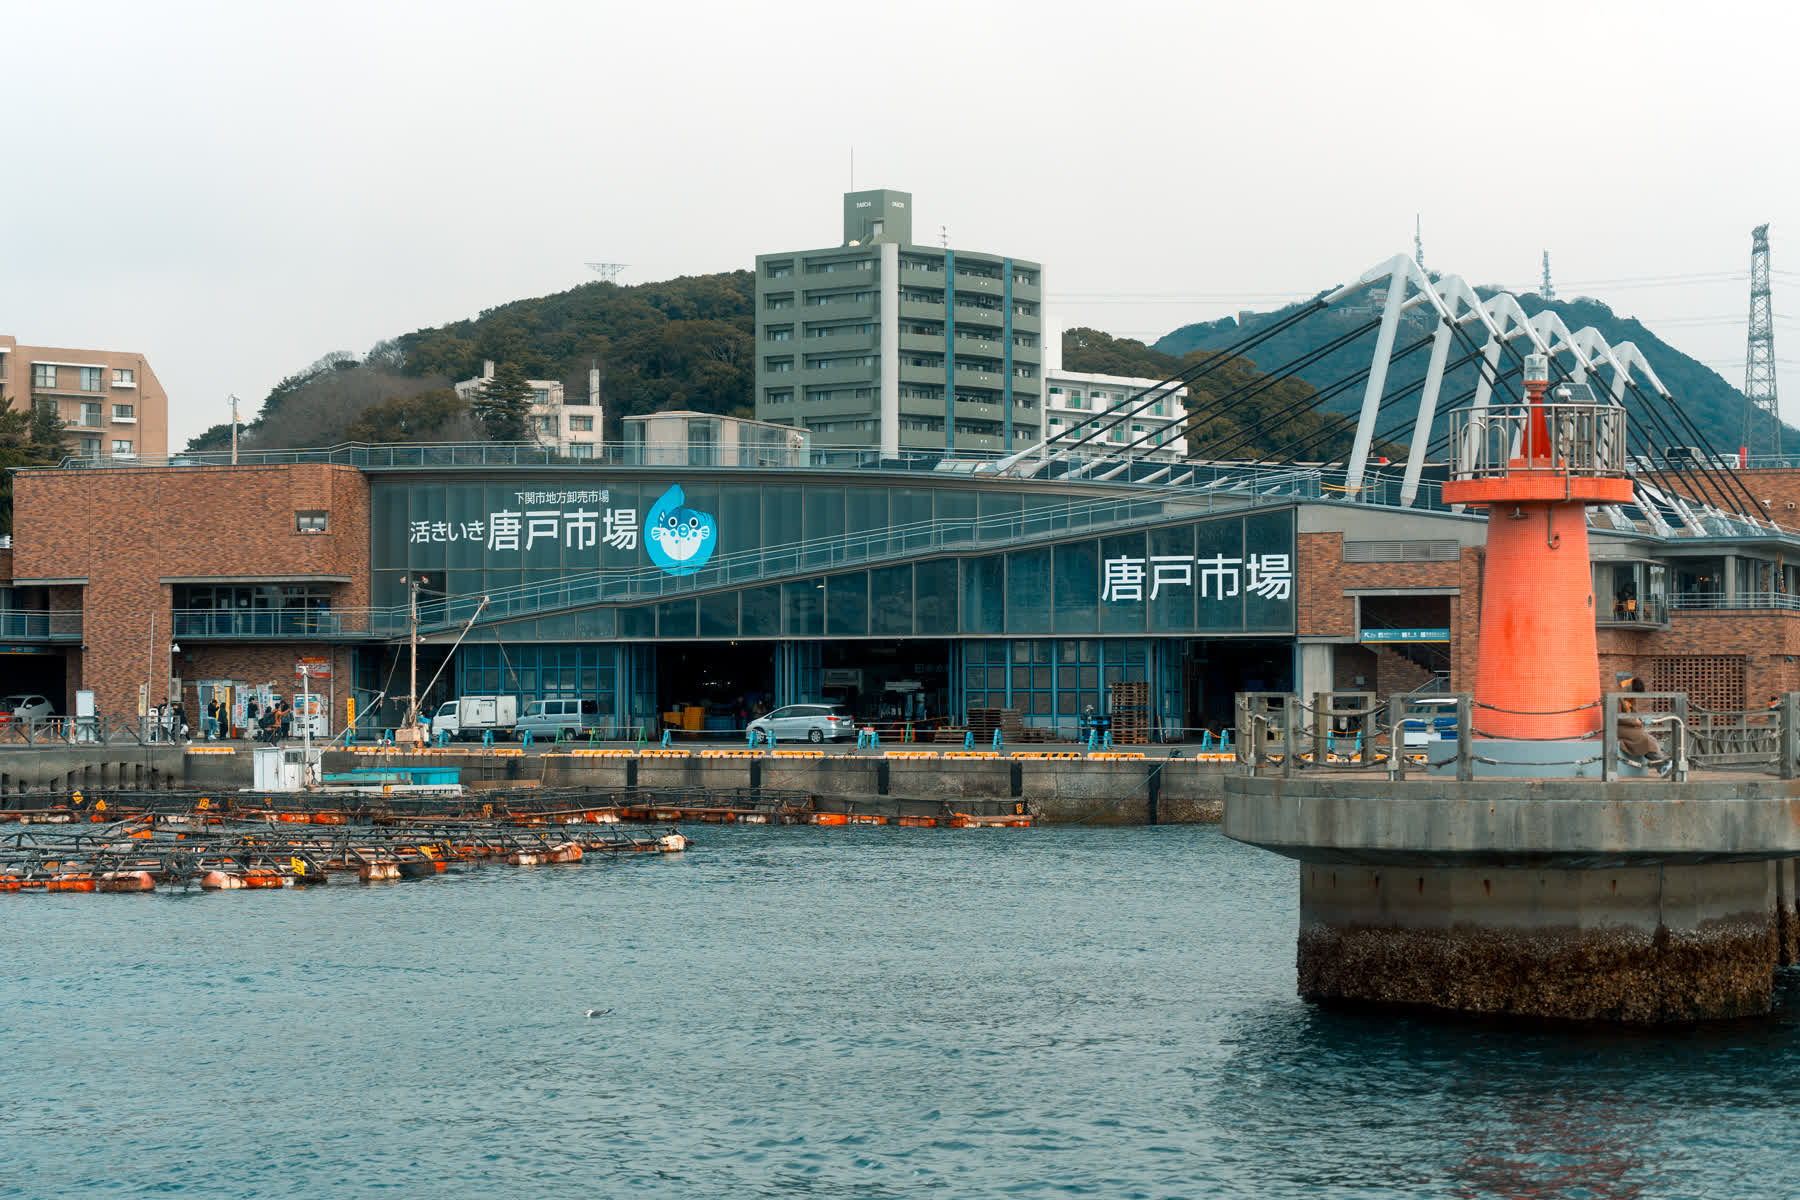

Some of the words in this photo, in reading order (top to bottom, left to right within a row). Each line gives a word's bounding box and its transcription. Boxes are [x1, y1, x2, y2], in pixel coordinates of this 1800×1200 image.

[514, 490, 609, 504] 下関市地方卸売市場
[1102, 553, 1292, 602] 唐戸市場
